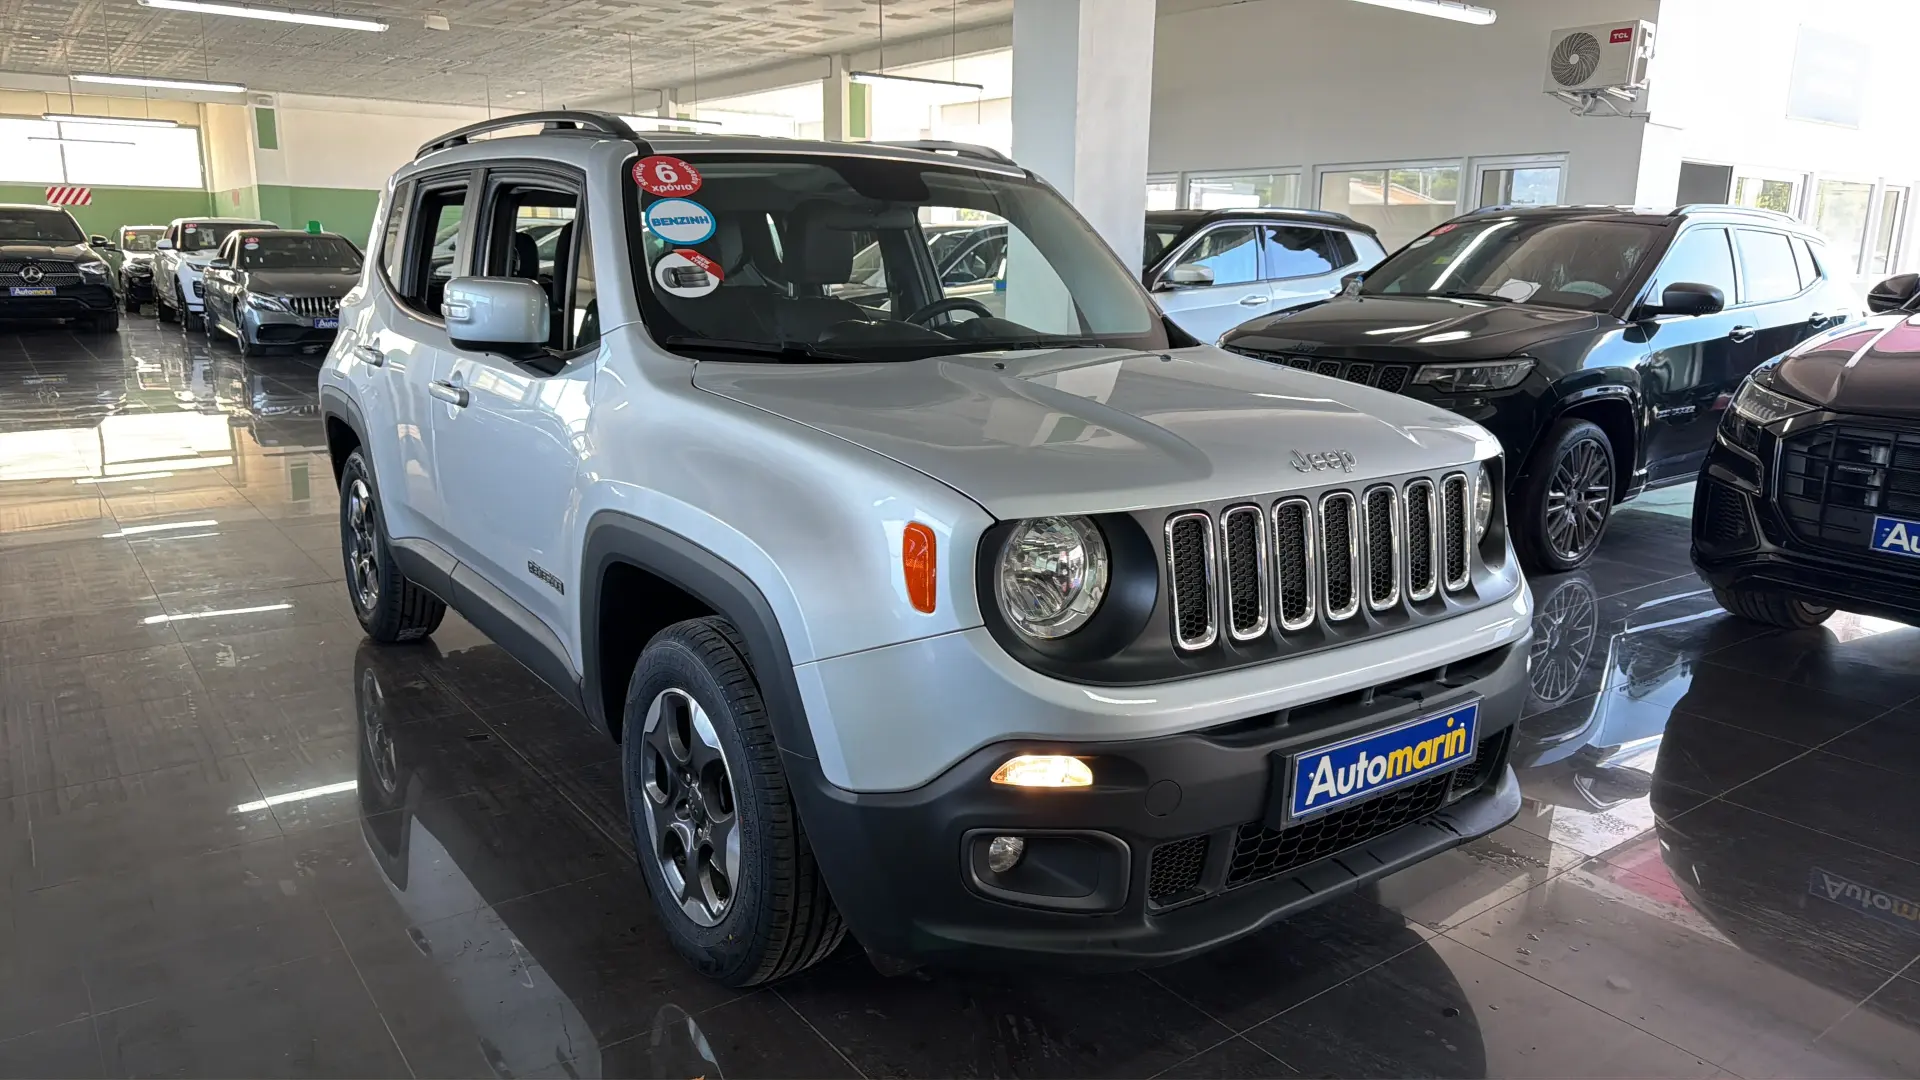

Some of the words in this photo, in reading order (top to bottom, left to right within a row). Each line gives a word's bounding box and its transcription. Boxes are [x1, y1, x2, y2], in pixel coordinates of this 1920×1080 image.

[655, 164, 679, 184] 6
[651, 183, 693, 193] χρόνια
[1290, 448, 1357, 473] Jeep
[1305, 717, 1466, 806] Automarin
